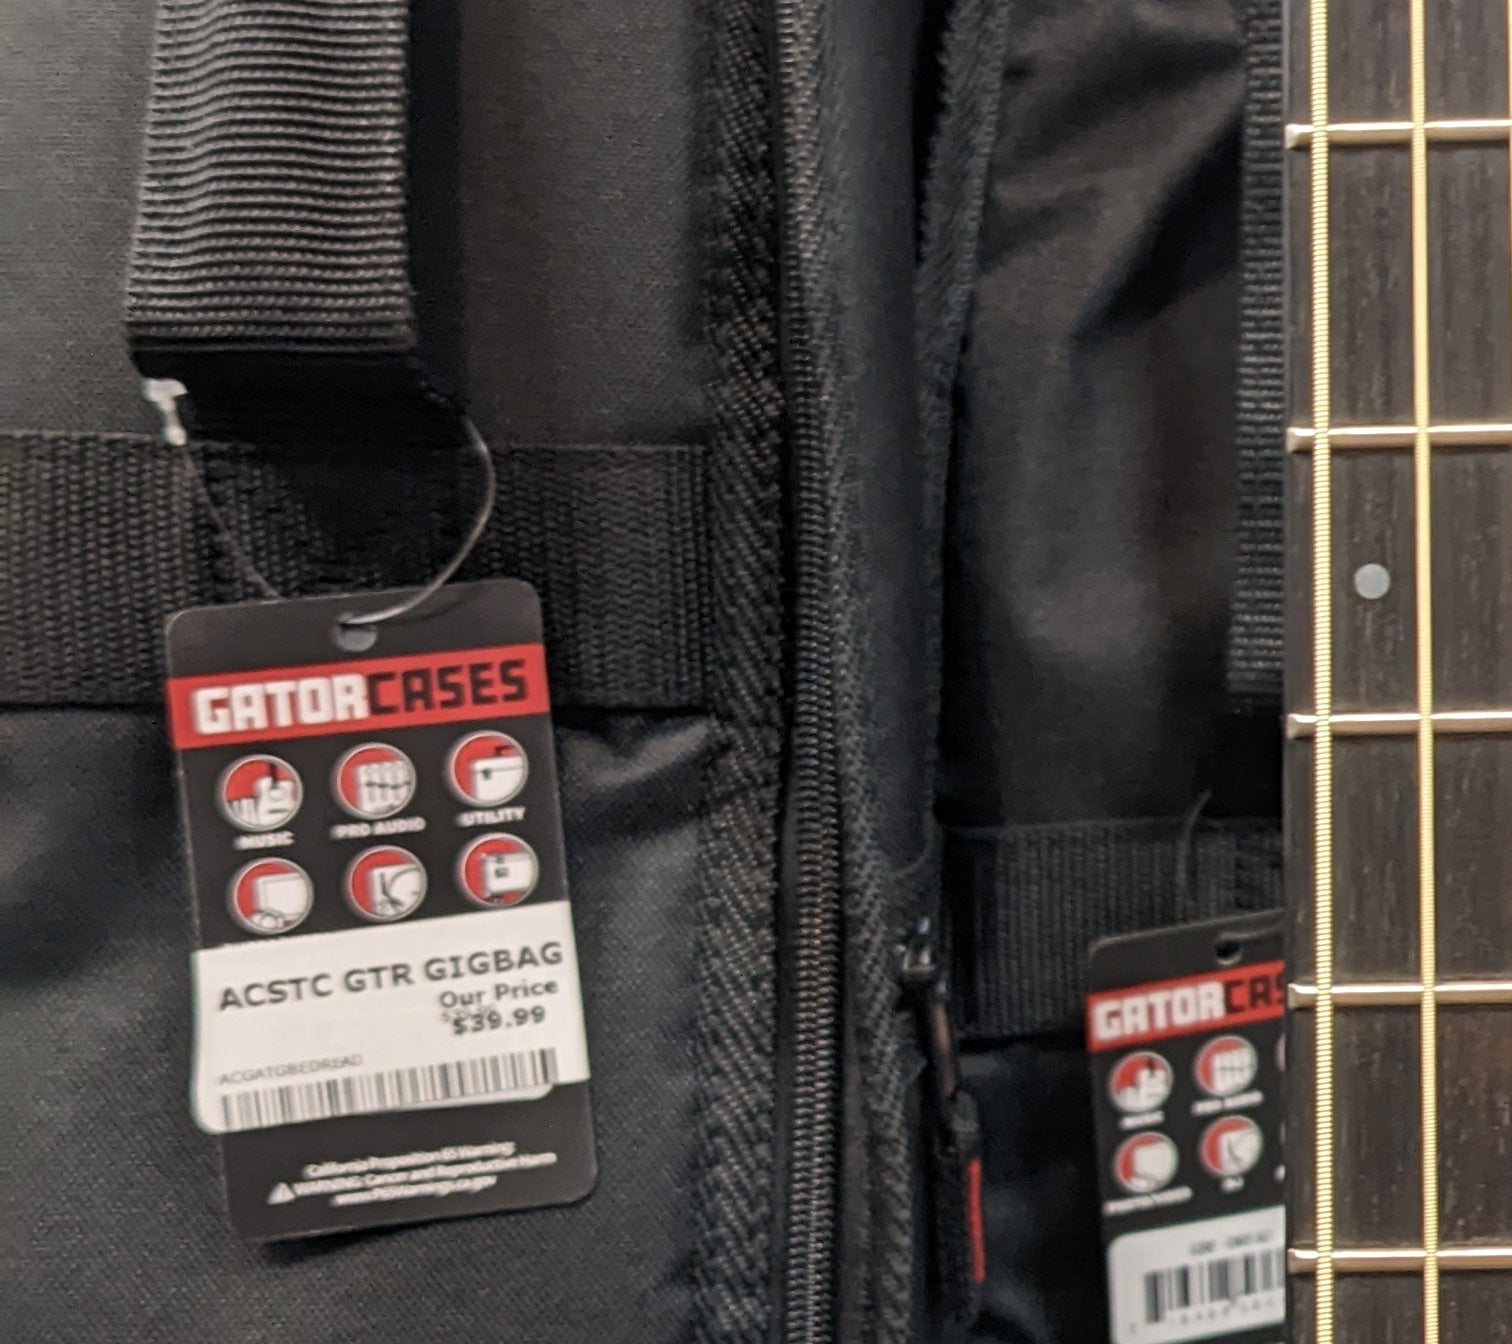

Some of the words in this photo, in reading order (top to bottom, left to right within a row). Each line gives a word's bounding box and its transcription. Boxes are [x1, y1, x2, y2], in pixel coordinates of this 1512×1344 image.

[192, 658, 527, 735] GATORCASES
[456, 806, 526, 828] UTILITY
[234, 830, 295, 851] MUSIC
[218, 973, 334, 1011] ACSTC
[343, 962, 416, 994] GTR
[424, 941, 565, 983] GIGBAG
[440, 989, 486, 1009] Our
[494, 978, 558, 1002] Price
[453, 1005, 546, 1035] $39.99
